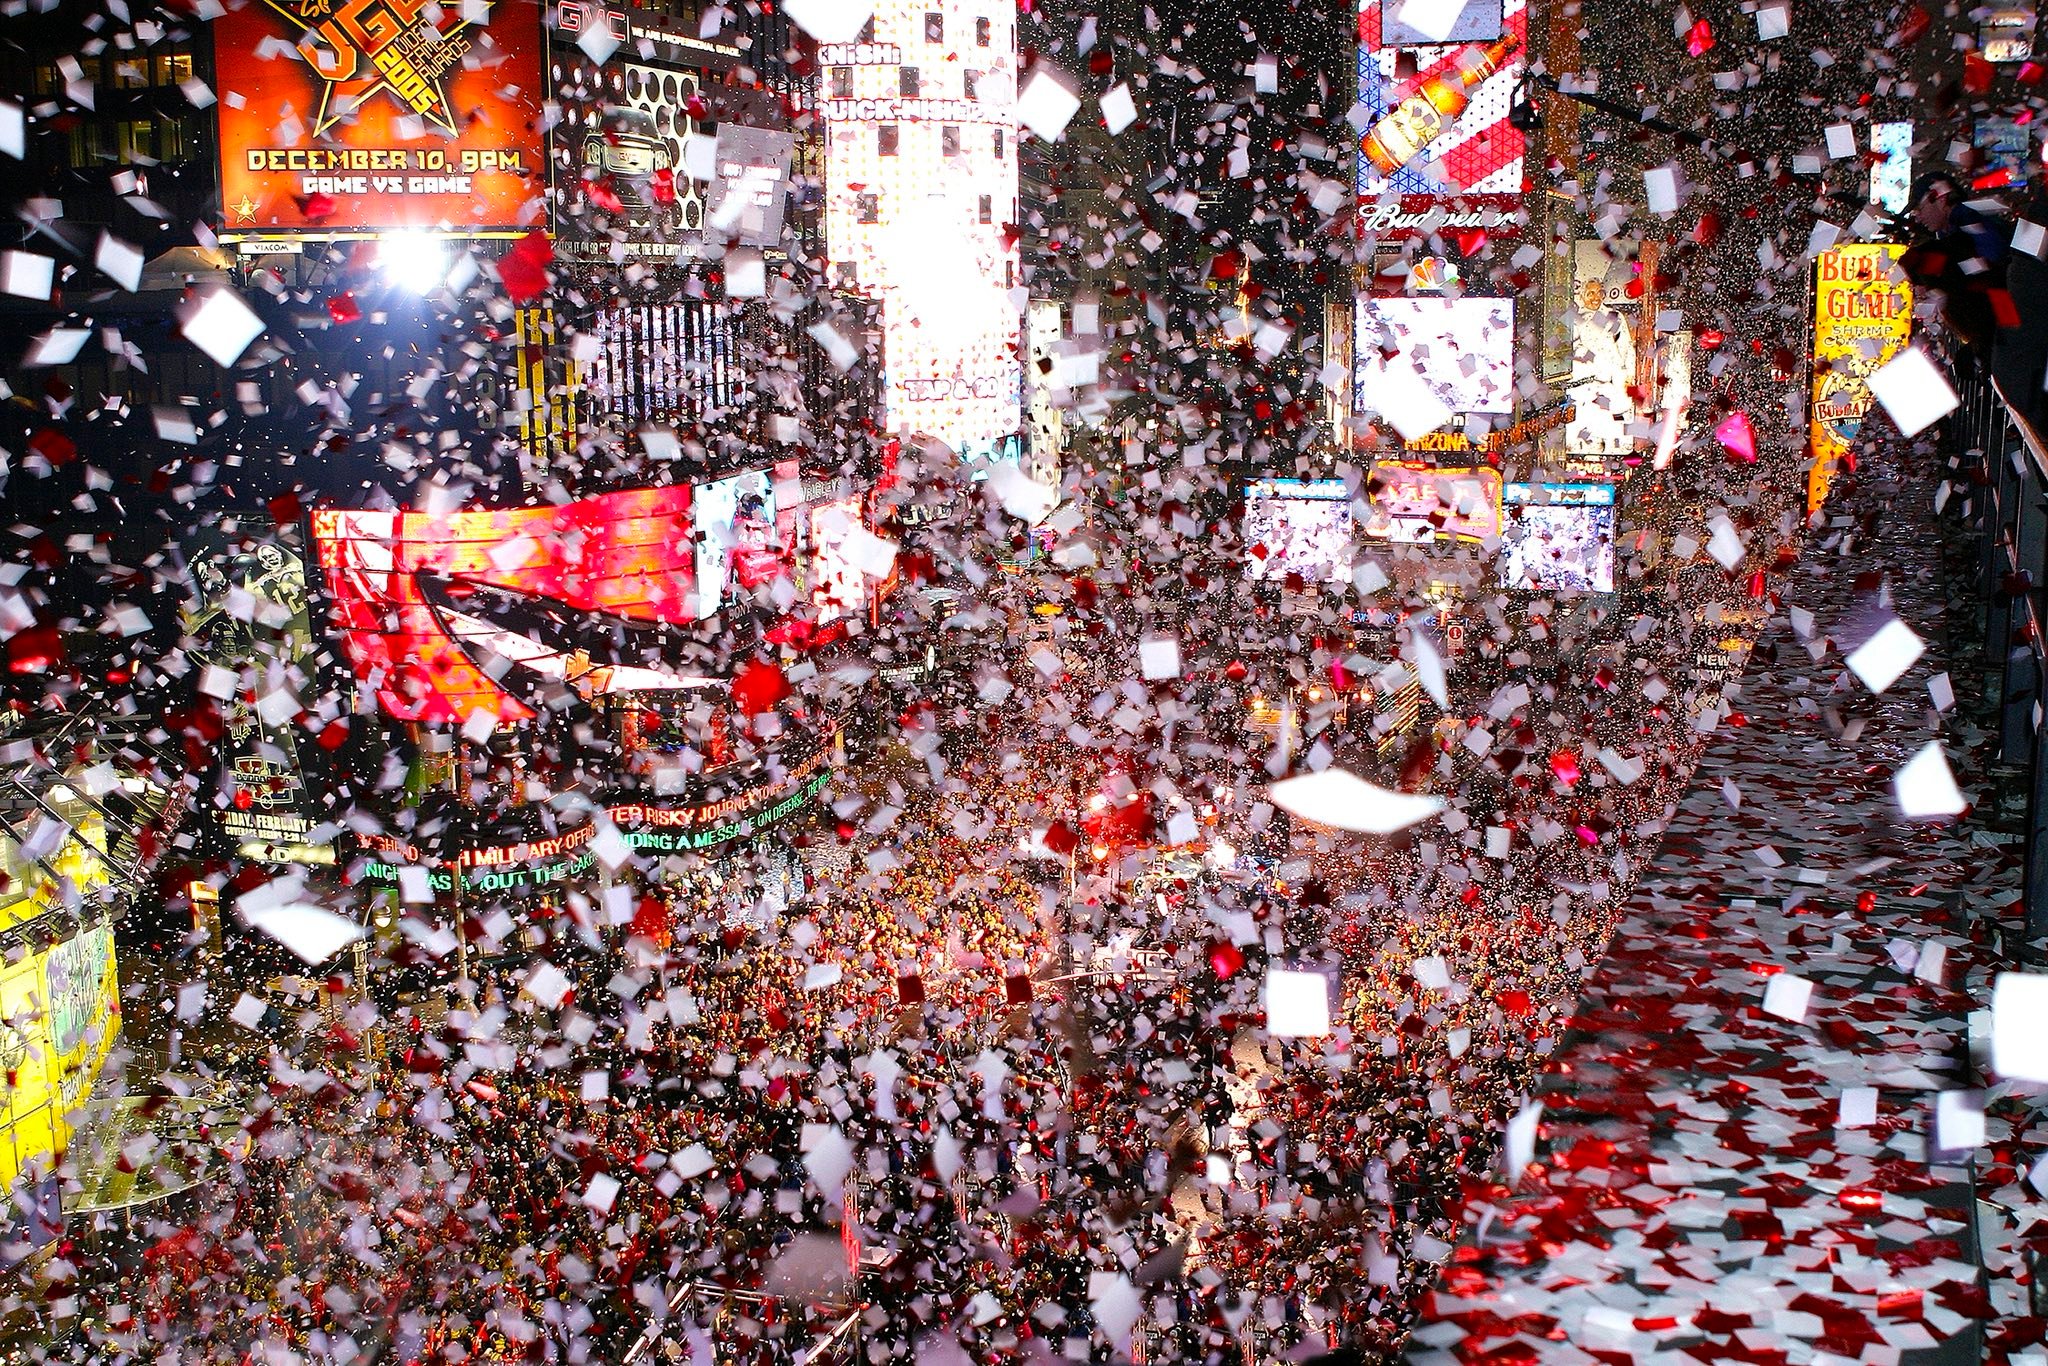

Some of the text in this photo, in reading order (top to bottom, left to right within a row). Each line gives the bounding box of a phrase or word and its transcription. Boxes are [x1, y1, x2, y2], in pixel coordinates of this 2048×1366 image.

[418, 34, 472, 84] AWARDS
[373, 44, 440, 115] 2005
[247, 149, 408, 171] DECEMBER
[461, 150, 522, 173] 9PM
[302, 176, 473, 194] GAME VS GAME
[1358, 203, 1520, 233] Budeier
[253, 243, 290, 252] VIACOM
[1833, 326, 1893, 335] SHRIMP
[1404, 432, 1470, 451] ARIZONA
[1507, 484, 1610, 503] Paanic
[880, 666, 924, 677] STARCKS
[256, 815, 307, 833] FEBRUARY
[474, 837, 562, 865] MILIARY
[646, 807, 695, 826] RISKY
[365, 862, 402, 883] NIGH
[531, 861, 568, 884] THE
[676, 834, 691, 850] A
[693, 816, 755, 848] MESSAE
[757, 809, 772, 827] ON
